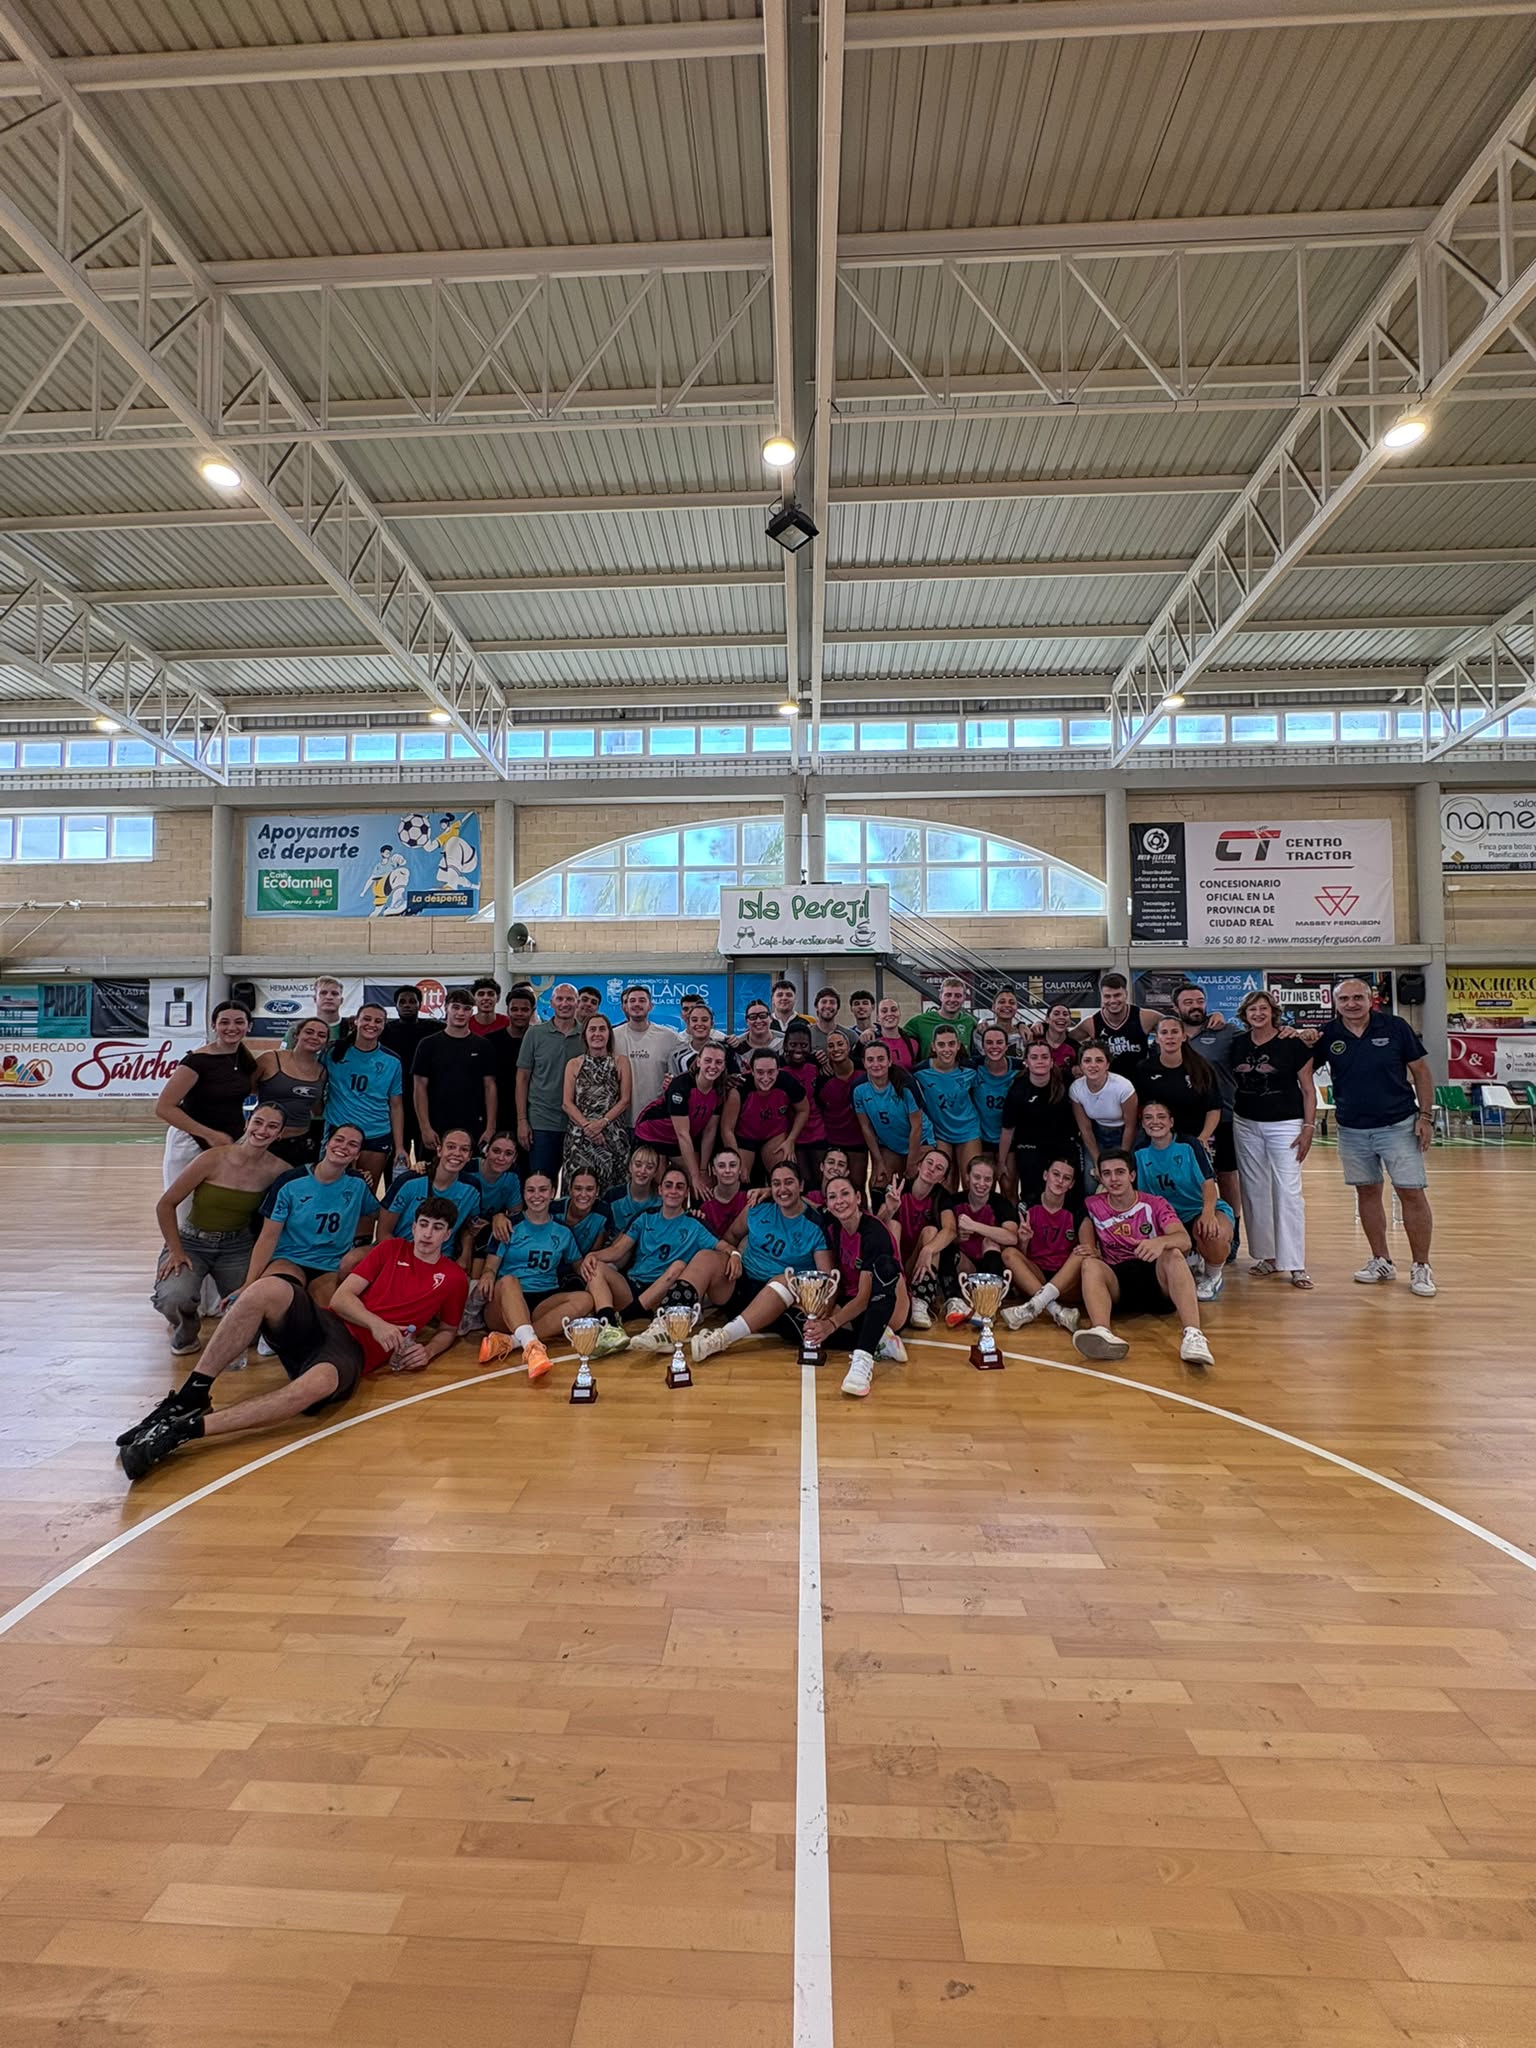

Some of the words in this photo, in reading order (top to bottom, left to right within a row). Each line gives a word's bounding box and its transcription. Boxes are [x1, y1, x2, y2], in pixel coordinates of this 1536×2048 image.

[258, 824, 360, 844] Apoyamos
[1215, 830, 1281, 861] CT
[1286, 838, 1342, 848] CENTRO
[258, 844, 276, 859] el
[281, 843, 360, 863] deporte
[1286, 851, 1352, 860] TRACTOR
[263, 876, 333, 888] Ecofamilia
[1199, 879, 1281, 889] CONCESIONARIO
[412, 895, 422, 903] La
[424, 894, 468, 905] despensa
[1206, 893, 1245, 901] OFICIAL
[1247, 893, 1260, 901] EN
[1262, 892, 1275, 901] LA
[738, 891, 780, 920] Isla
[1206, 906, 1260, 915] PROVINCIA
[1263, 906, 1275, 914] DE
[1209, 919, 1247, 928] CIUDAD
[1250, 919, 1274, 927] REAL
[1205, 936, 1221, 945] 926
[1223, 936, 1234, 945] 50
[1235, 936, 1247, 944] 80
[1249, 936, 1260, 944] 12
[1267, 935, 1381, 947] www.masseyferguson.com
[1044, 981, 1092, 989] CALATRAVA
[1197, 976, 1241, 984] AZULEJOS
[422, 987, 443, 1006] itt
[626, 983, 709, 997] LAÑOS
[1469, 992, 1518, 1000] MANCHA,
[272, 1001, 295, 1012] Ford
[1448, 1037, 1467, 1061] D
[1469, 1053, 1482, 1066] &
[1486, 1051, 1498, 1078] J
[350, 1074, 368, 1092] 10
[985, 1095, 1005, 1109] 82
[880, 1111, 890, 1125] 5
[1156, 1173, 1176, 1191] 14
[315, 1213, 341, 1234] 78
[760, 1233, 785, 1256] 20
[527, 1250, 552, 1270] 55
